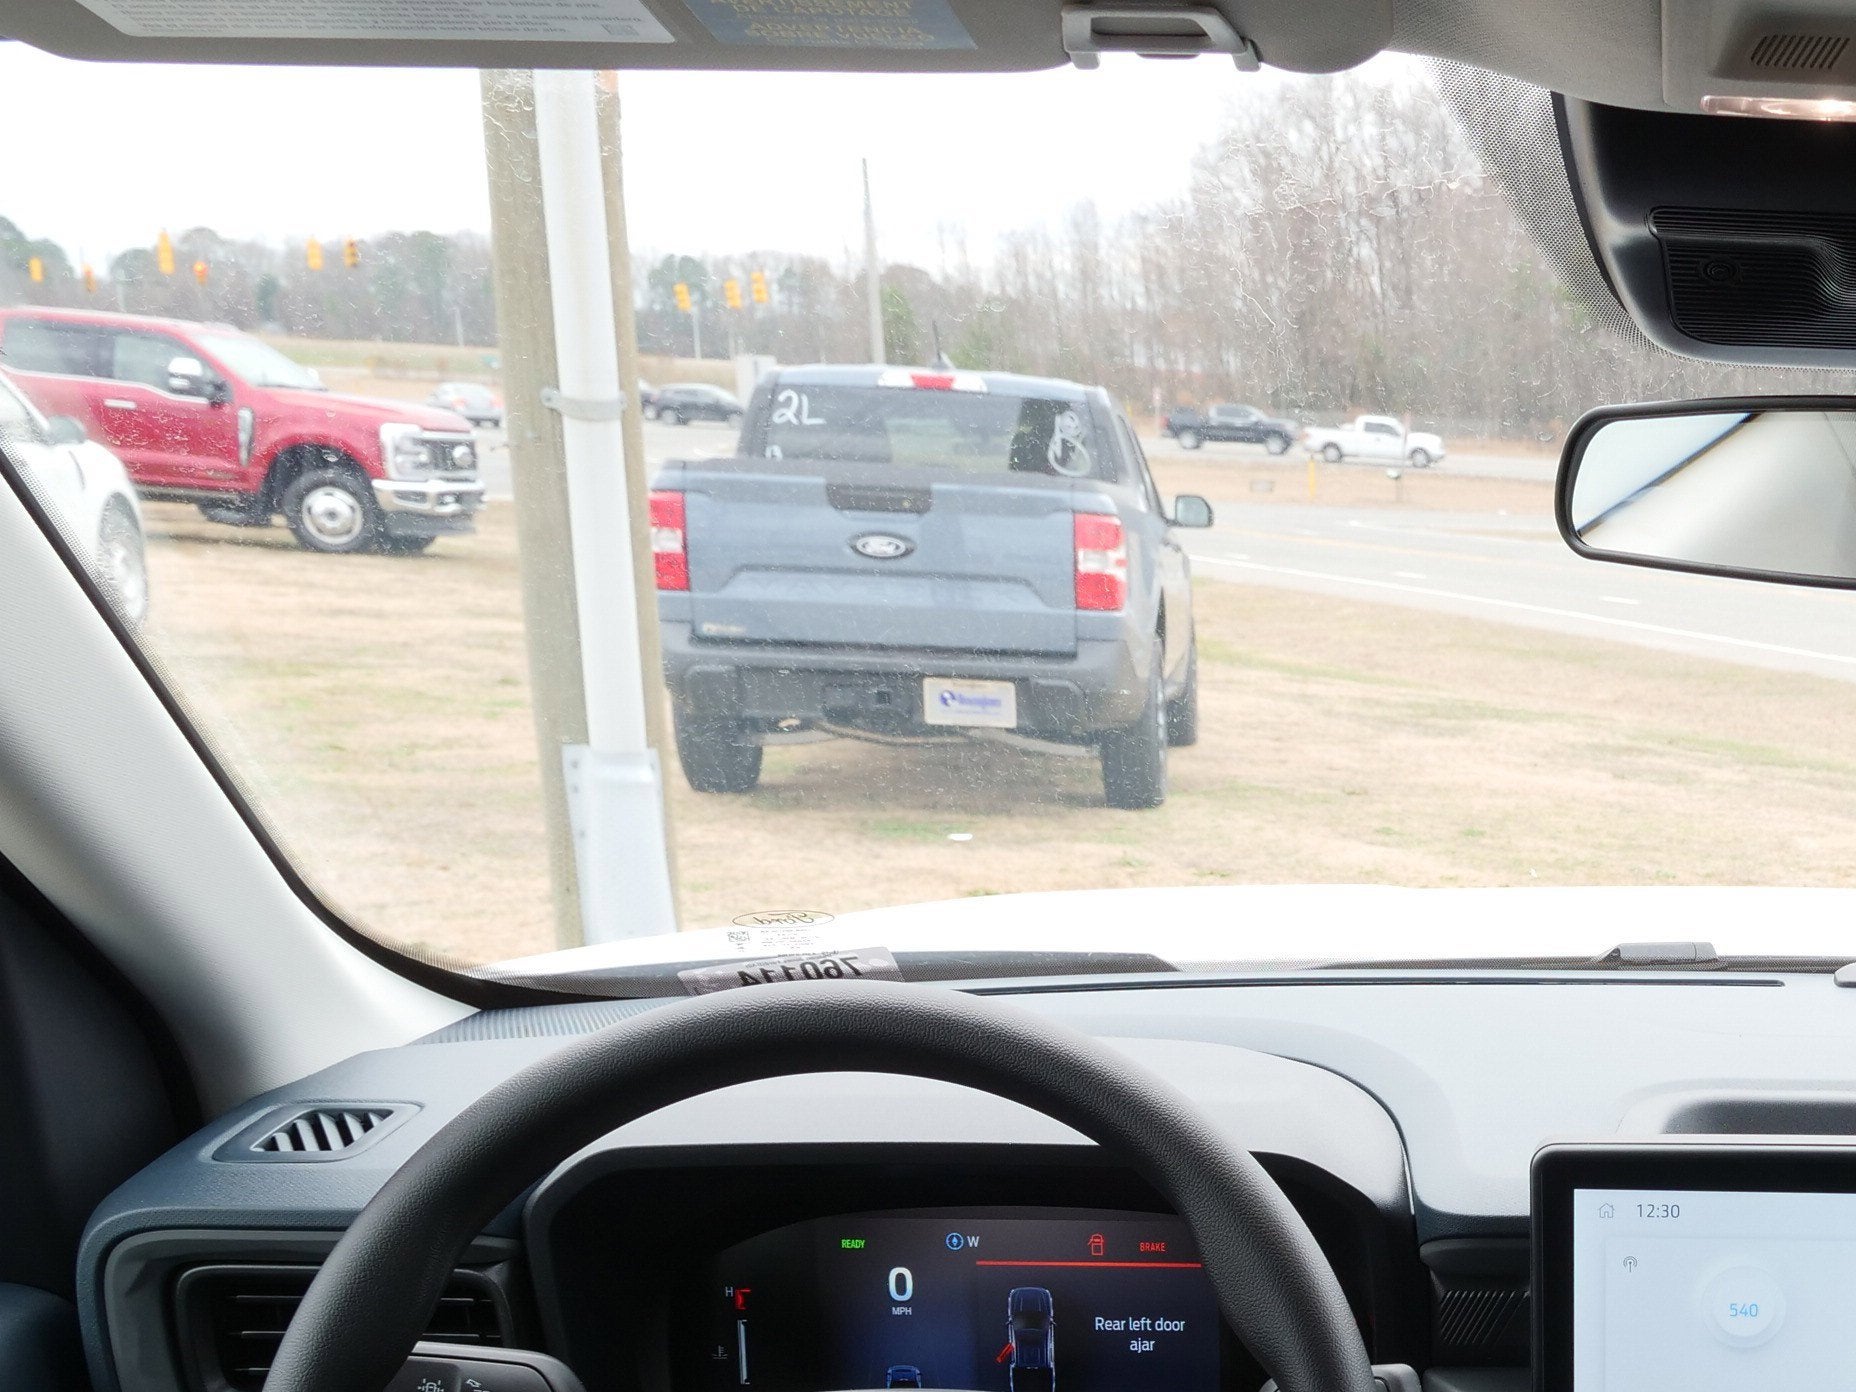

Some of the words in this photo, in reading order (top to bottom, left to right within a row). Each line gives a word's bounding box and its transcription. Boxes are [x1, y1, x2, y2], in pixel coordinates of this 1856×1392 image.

[1636, 1204, 1681, 1219] 12:30
[841, 1239, 866, 1249] READY
[967, 1236, 980, 1248] W
[1139, 1242, 1166, 1252] BRAKE
[888, 1266, 914, 1302] 0
[725, 1286, 734, 1298] H
[892, 1306, 912, 1316] MPH
[1729, 1303, 1759, 1318] 540
[1094, 1316, 1126, 1331] Rear
[1129, 1316, 1151, 1331] left
[1154, 1317, 1186, 1332] door
[1130, 1337, 1156, 1354] ajar
